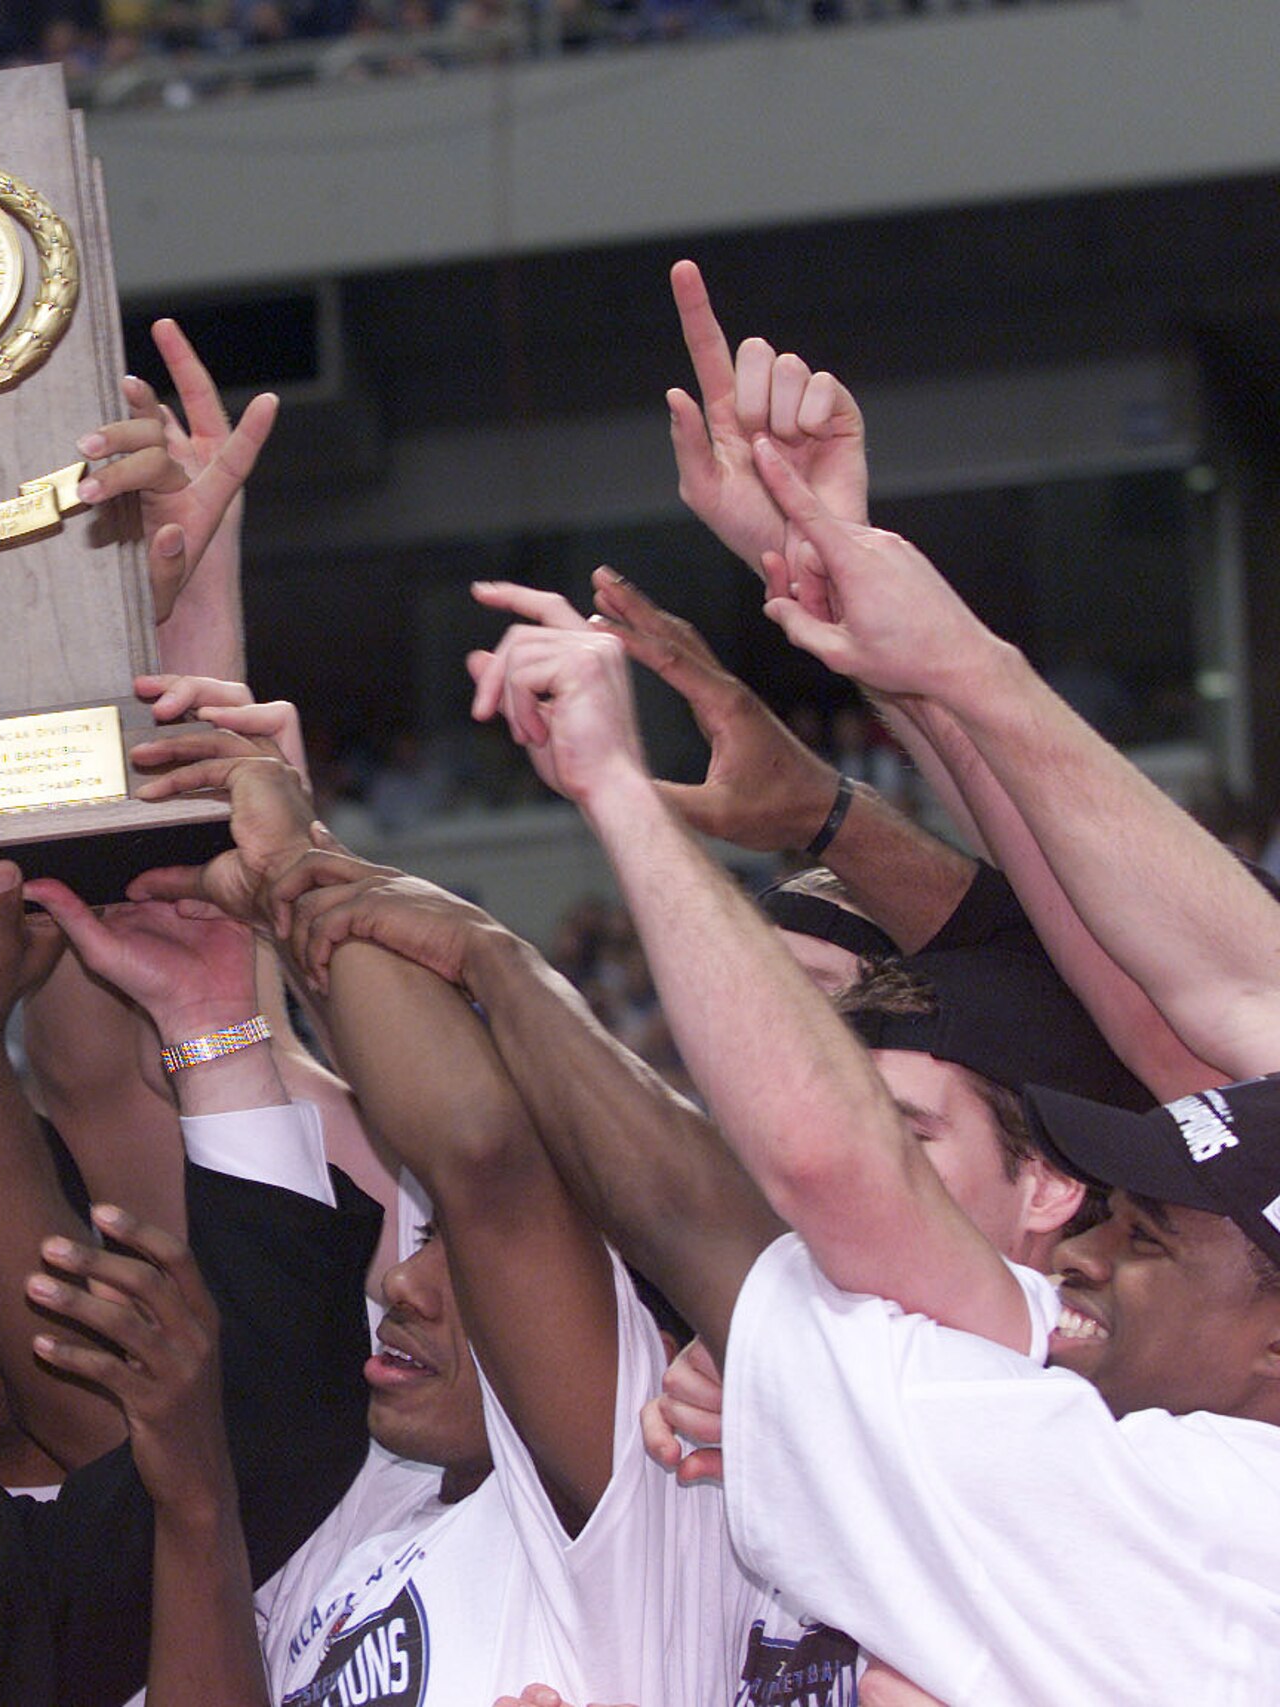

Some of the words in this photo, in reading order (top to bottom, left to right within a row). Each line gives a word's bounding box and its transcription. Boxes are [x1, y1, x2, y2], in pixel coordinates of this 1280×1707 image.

[35, 724, 90, 737] DIVISION
[15, 745, 94, 761] BASKETBALL
[38, 777, 102, 792] CHAMPION
